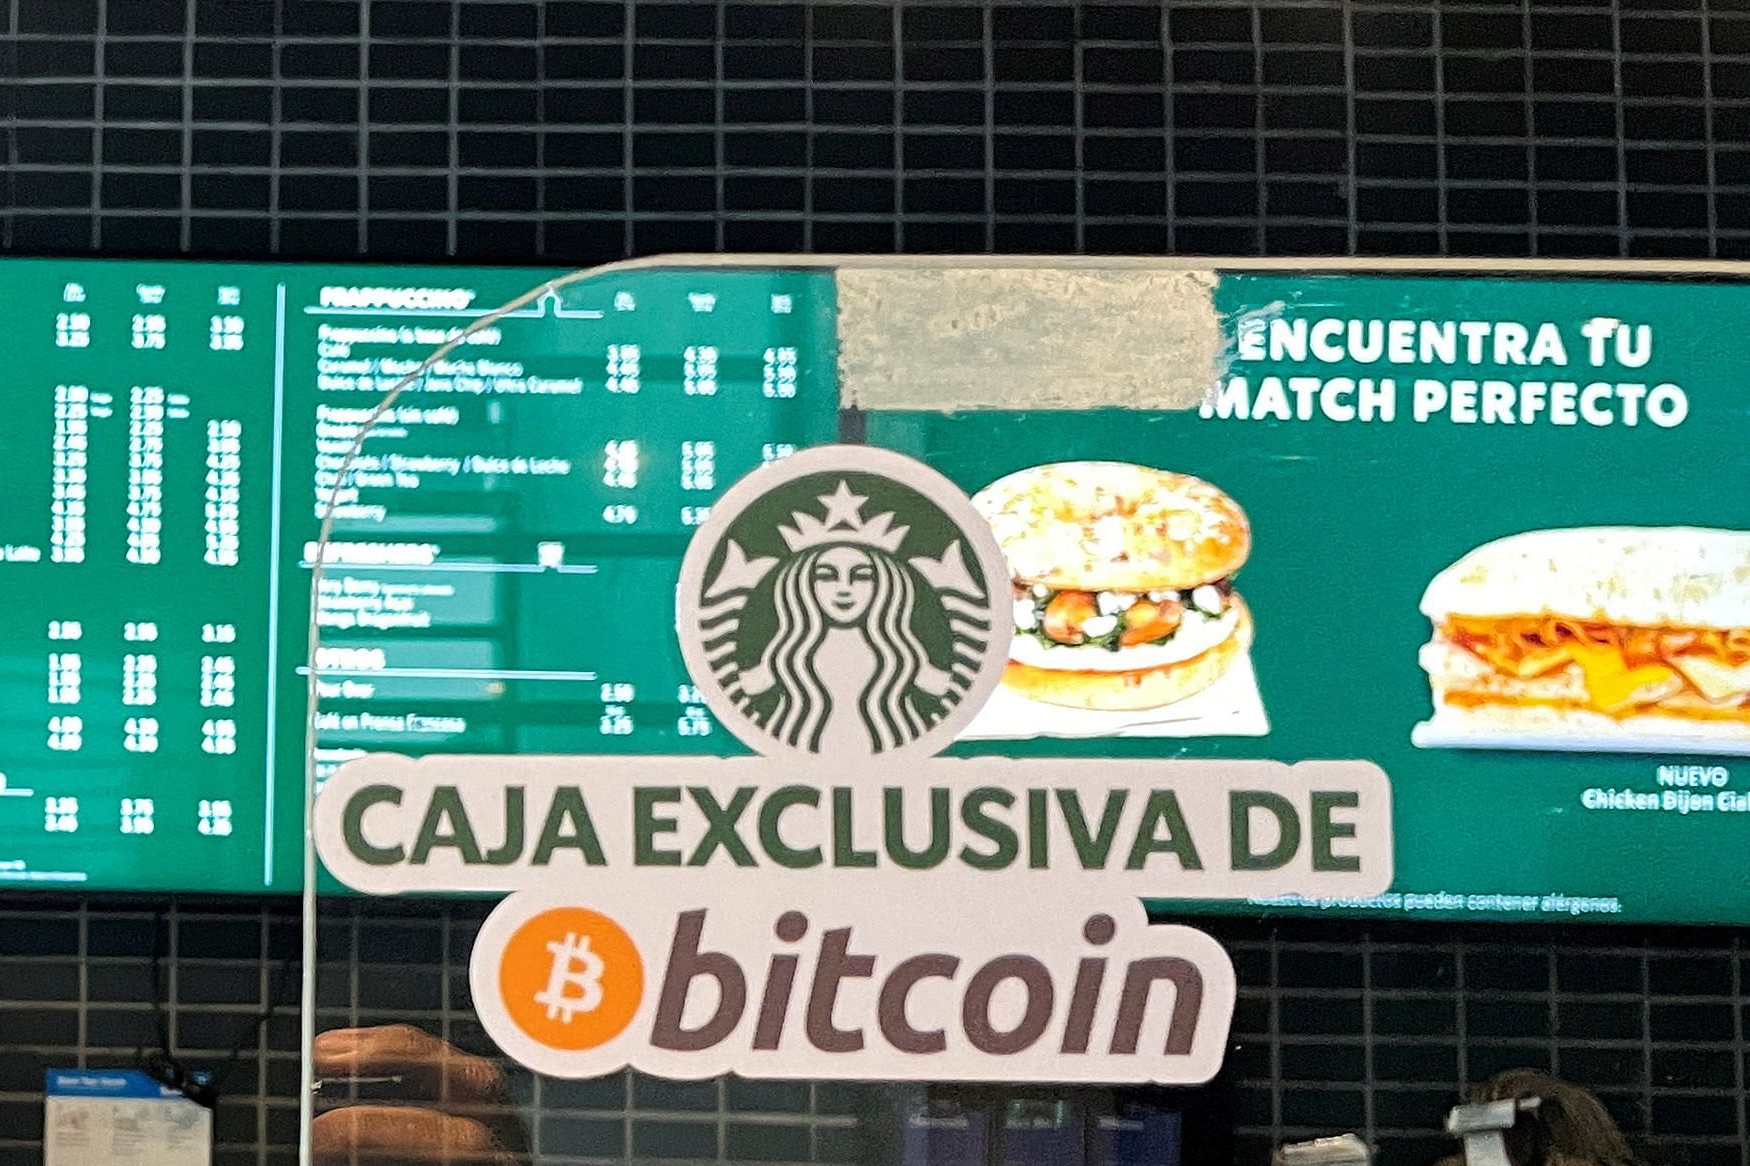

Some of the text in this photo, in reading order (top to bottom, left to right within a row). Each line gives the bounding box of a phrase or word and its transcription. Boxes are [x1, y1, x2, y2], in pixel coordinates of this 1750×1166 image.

[1237, 317, 1653, 368] ENCUENTRA TU
[1198, 377, 1690, 429] MATCH PERFECTO
[1580, 787, 1660, 811] Chicken
[1661, 789, 1715, 816] Dijon
[1656, 765, 1730, 788] NUEVO
[342, 783, 1361, 873] CAJA EXCLUSIVA DE
[650, 907, 1204, 1056] bitcoin
